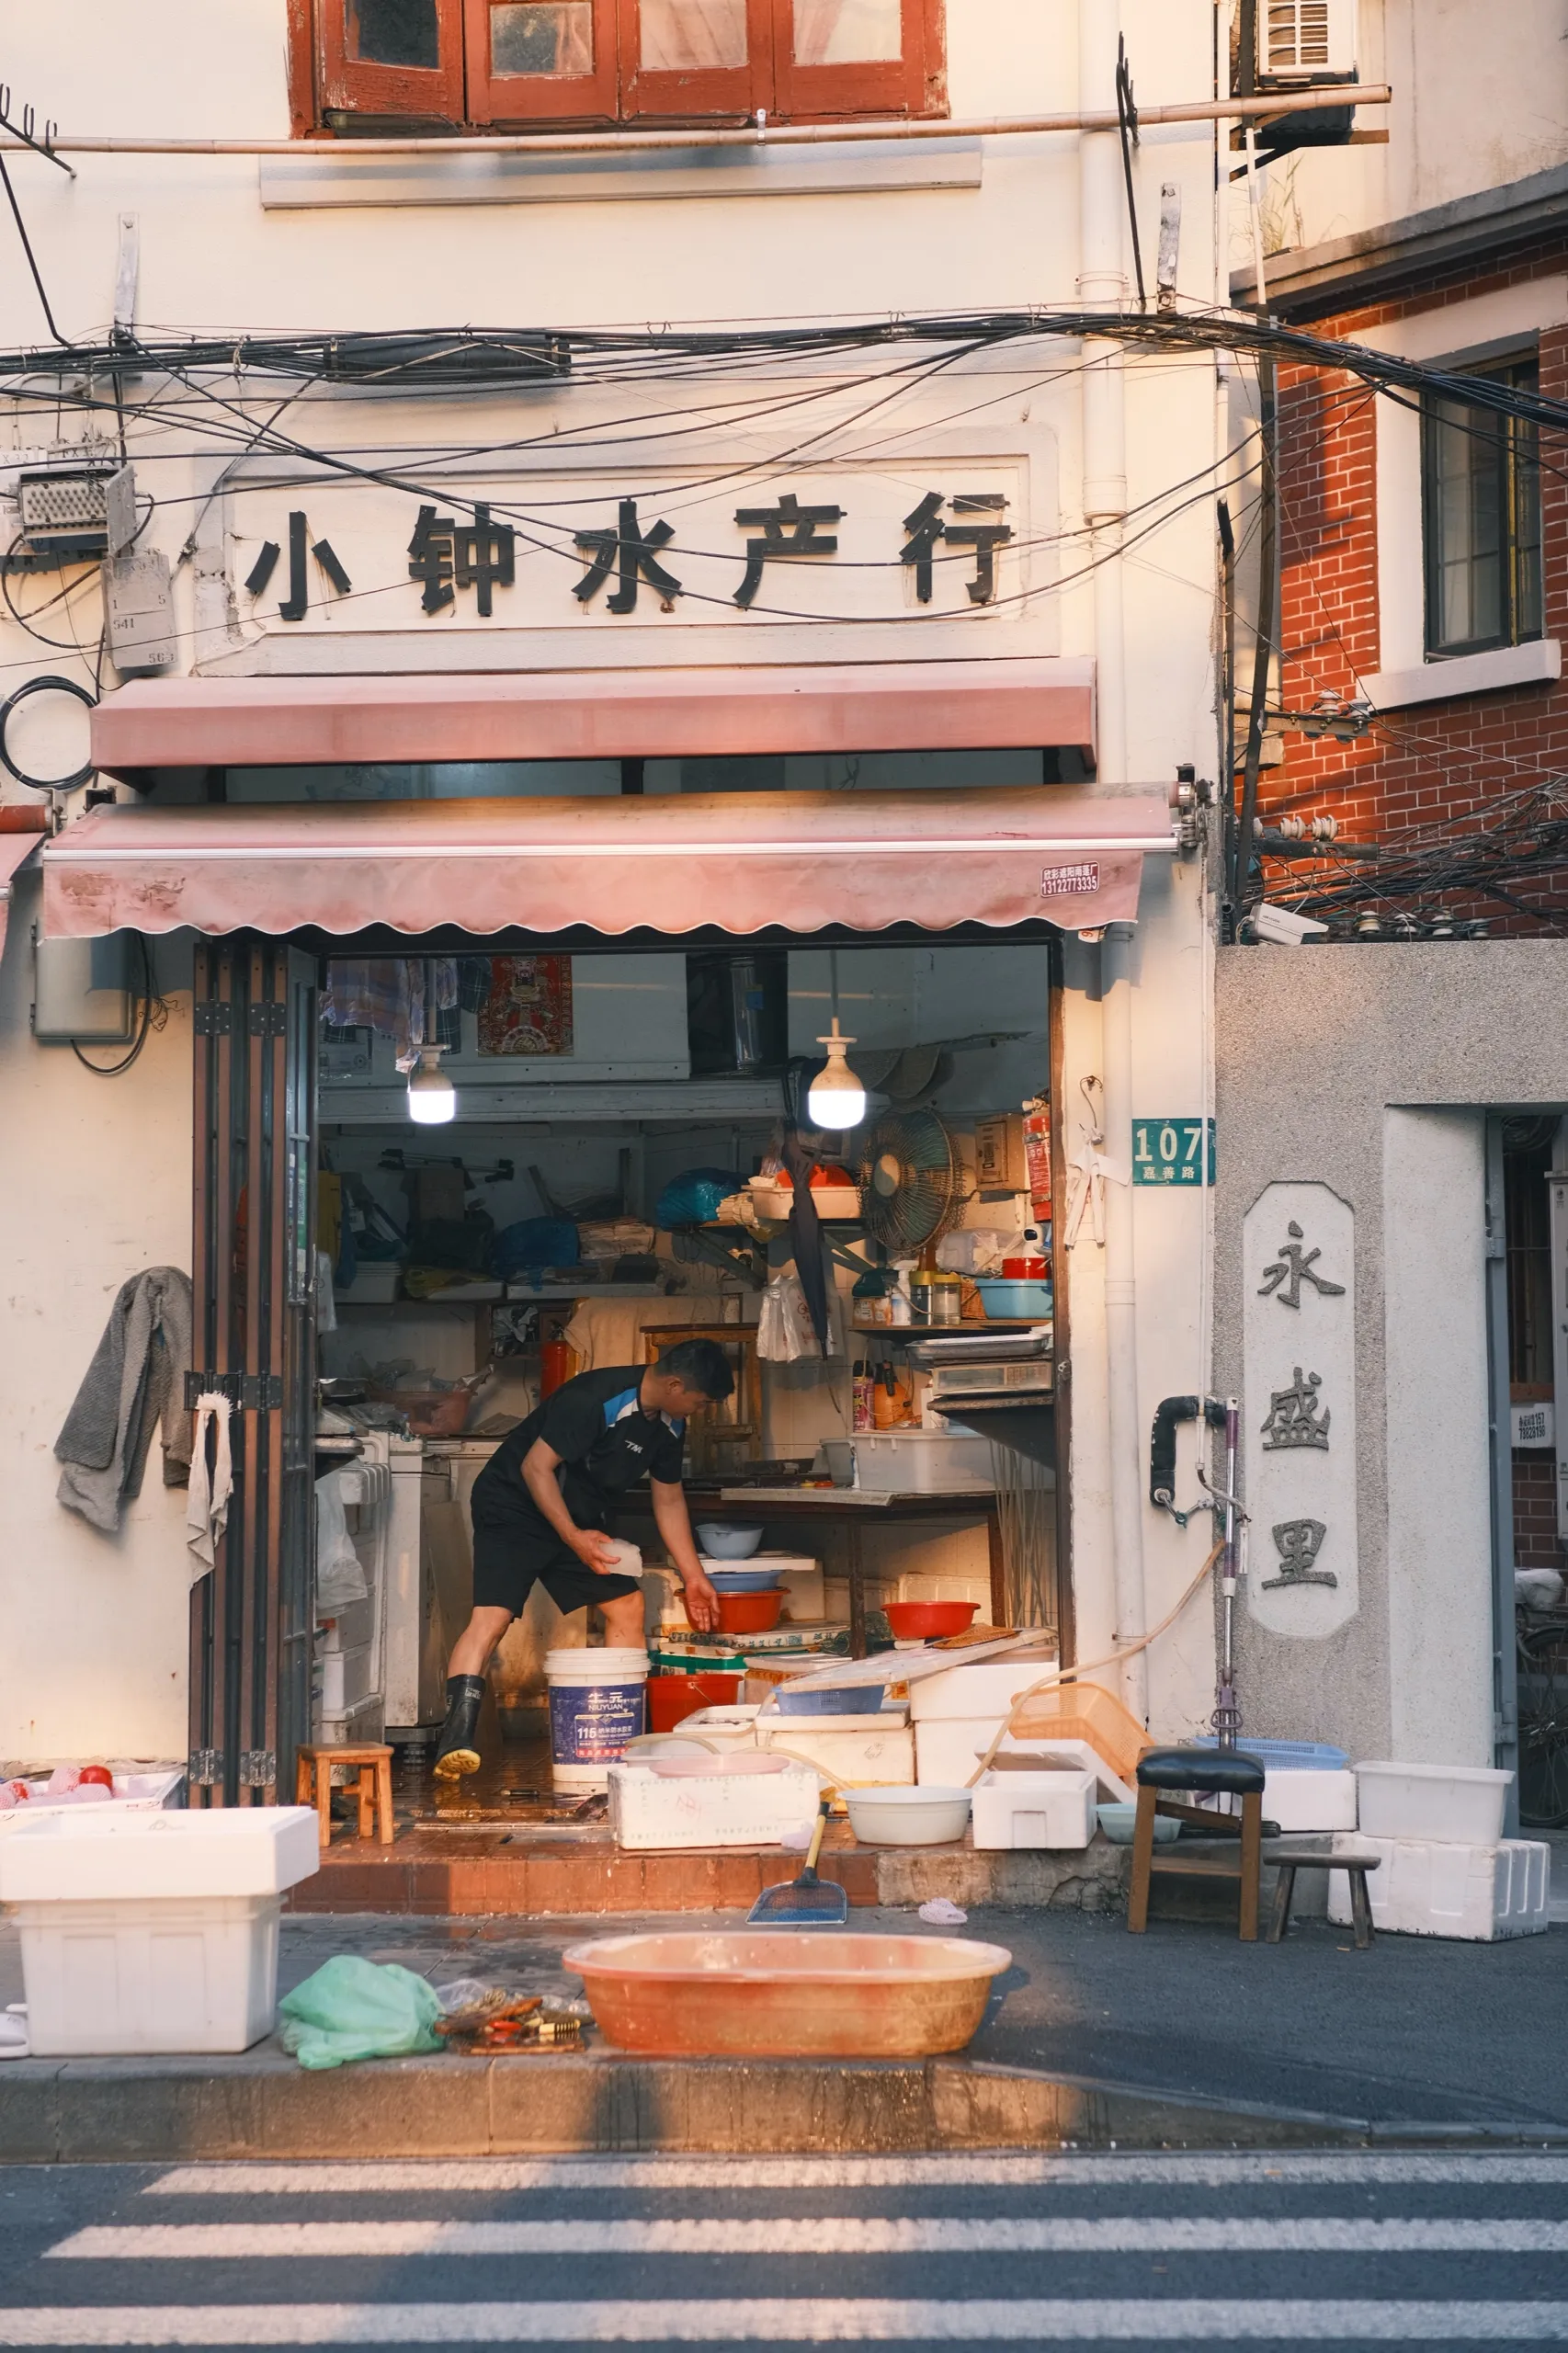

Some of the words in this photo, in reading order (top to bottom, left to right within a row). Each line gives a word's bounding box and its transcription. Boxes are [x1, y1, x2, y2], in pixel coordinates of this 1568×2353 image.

[244, 491, 1015, 621] 小钟水产行
[113, 598, 119, 609] 1
[157, 594, 166, 605] 5
[113, 618, 135, 630] 541
[1041, 876, 1097, 894] 13122773335
[1135, 1127, 1201, 1161] 107
[1142, 1166, 1195, 1179] 嘉善路
[1257, 1220, 1346, 1589] 永盛里
